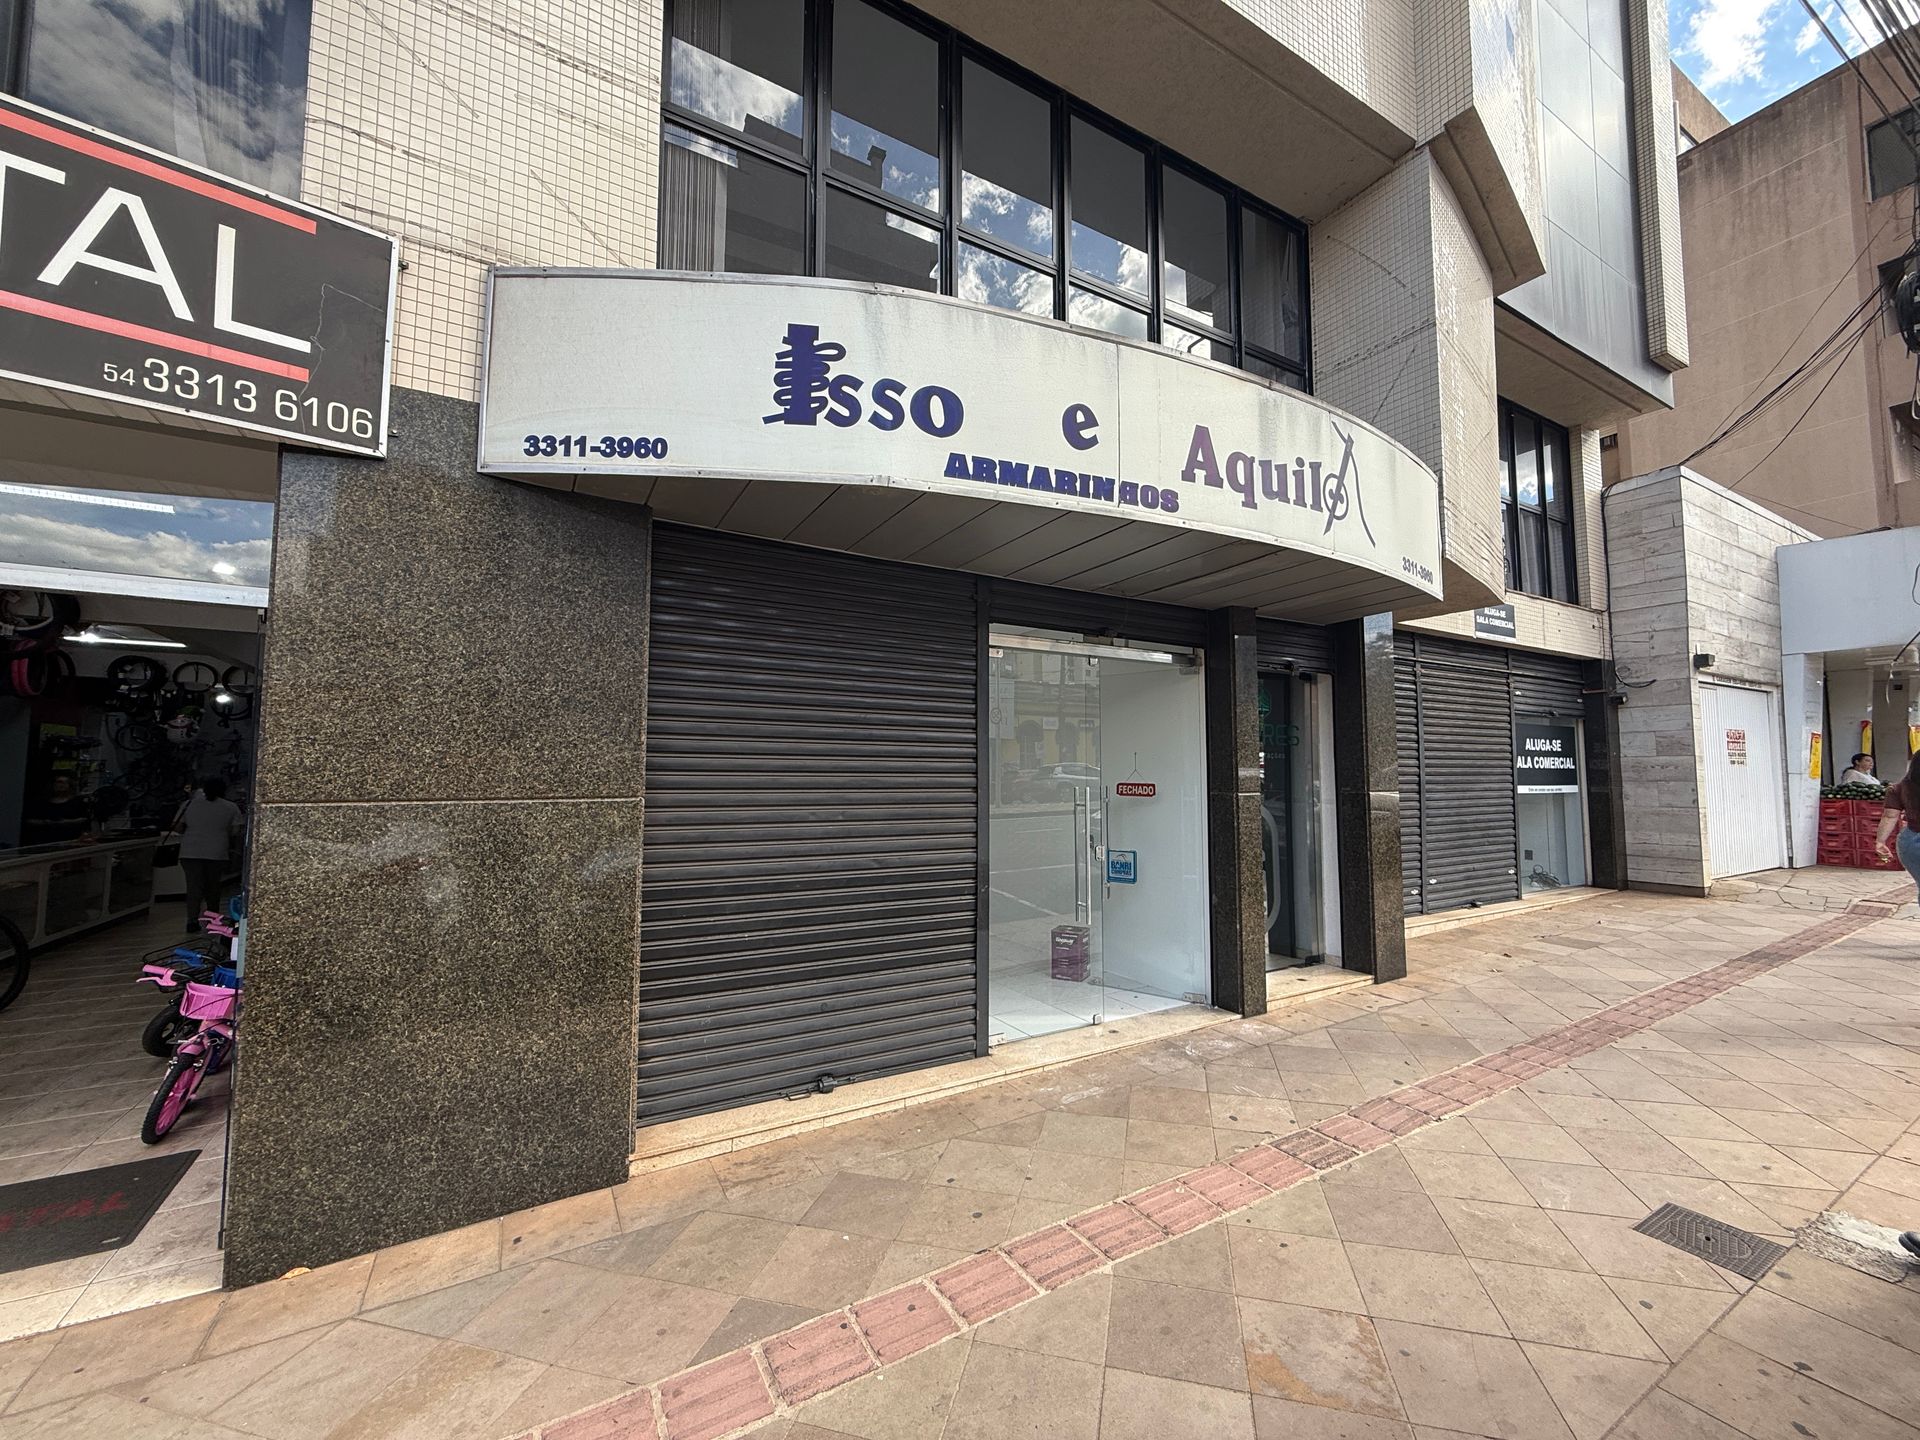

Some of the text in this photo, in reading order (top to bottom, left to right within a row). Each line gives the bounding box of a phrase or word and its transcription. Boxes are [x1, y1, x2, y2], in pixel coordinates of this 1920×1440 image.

[103, 357, 373, 439] 54 3313 6106
[1061, 403, 1100, 451] e
[523, 434, 669, 460] 3311-3960
[943, 452, 1181, 513] ARMARINHOS
[1525, 738, 1562, 752] ALUGA-SE
[1533, 756, 1576, 769] COMERCIAL
[1118, 784, 1154, 795] FECHADO
